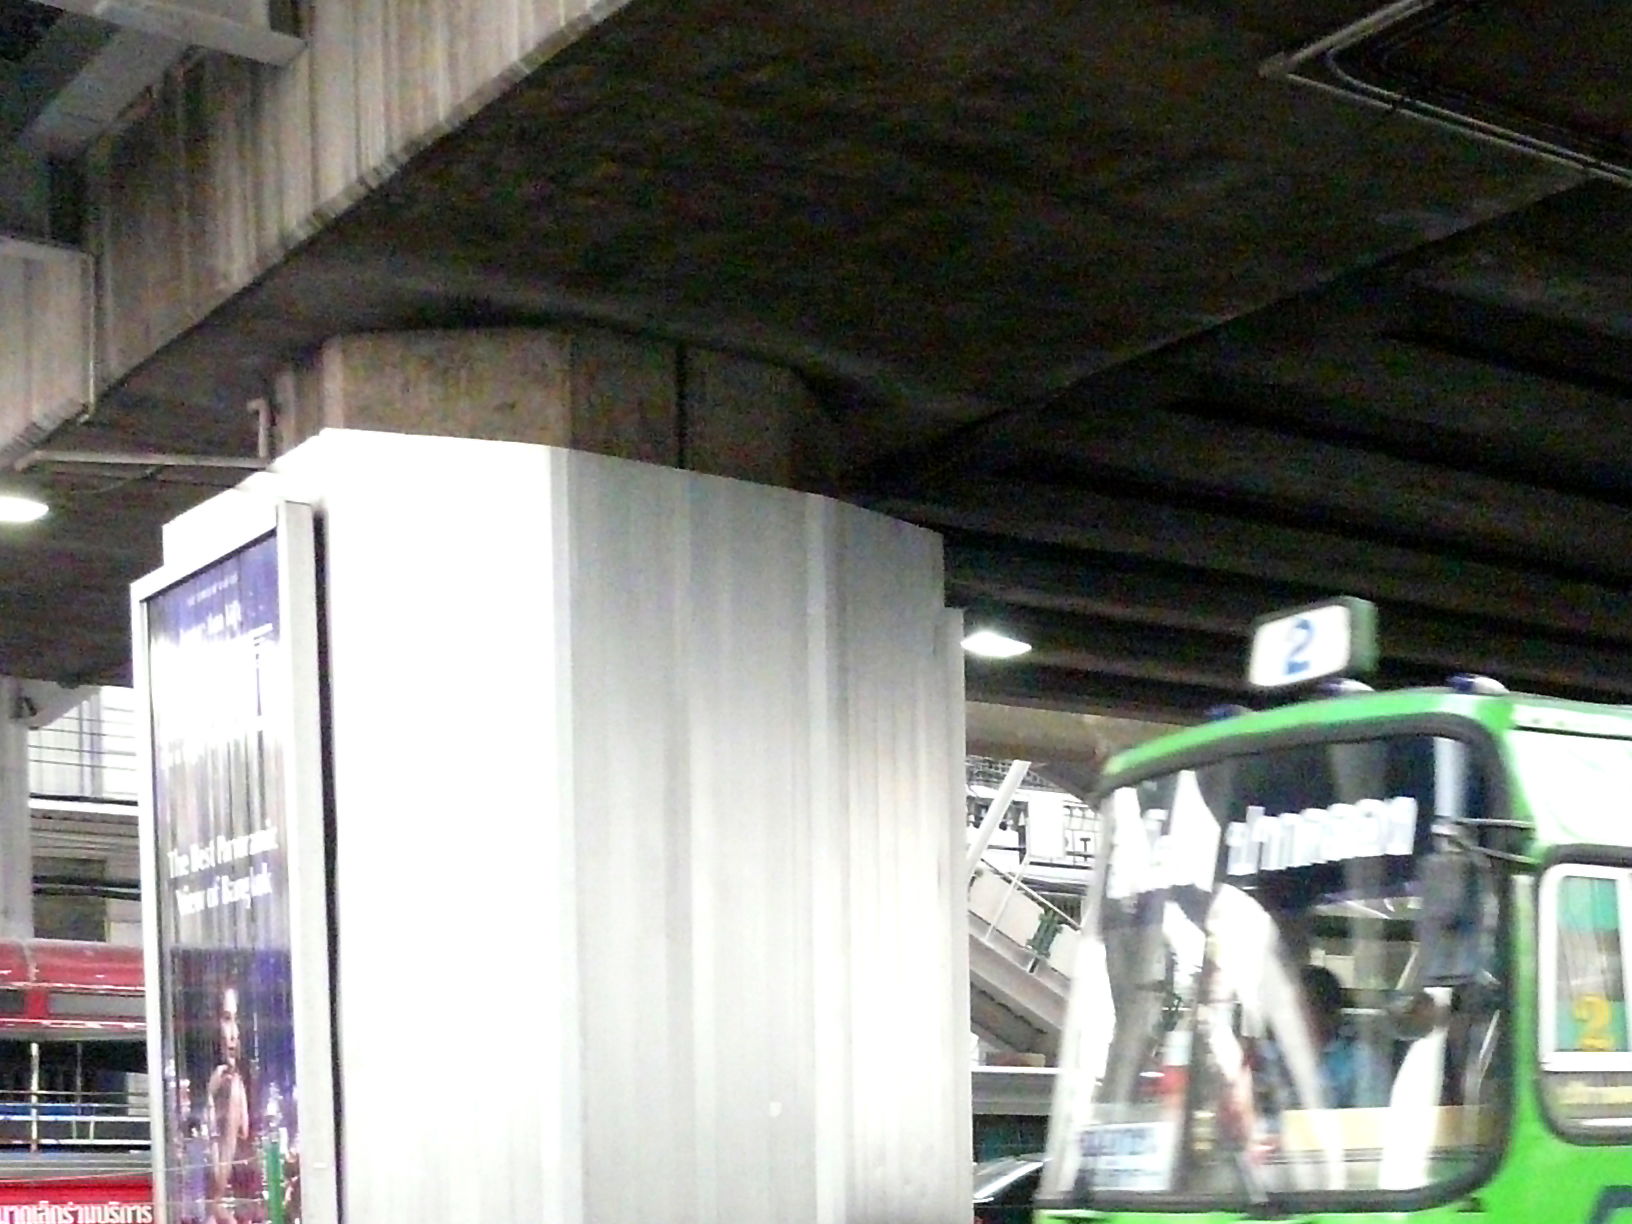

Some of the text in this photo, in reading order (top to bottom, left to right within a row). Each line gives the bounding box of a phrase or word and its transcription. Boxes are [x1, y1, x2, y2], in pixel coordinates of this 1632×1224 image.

[1285, 618, 1315, 675] 2
[167, 848, 190, 878] The
[190, 839, 215, 872] Best
